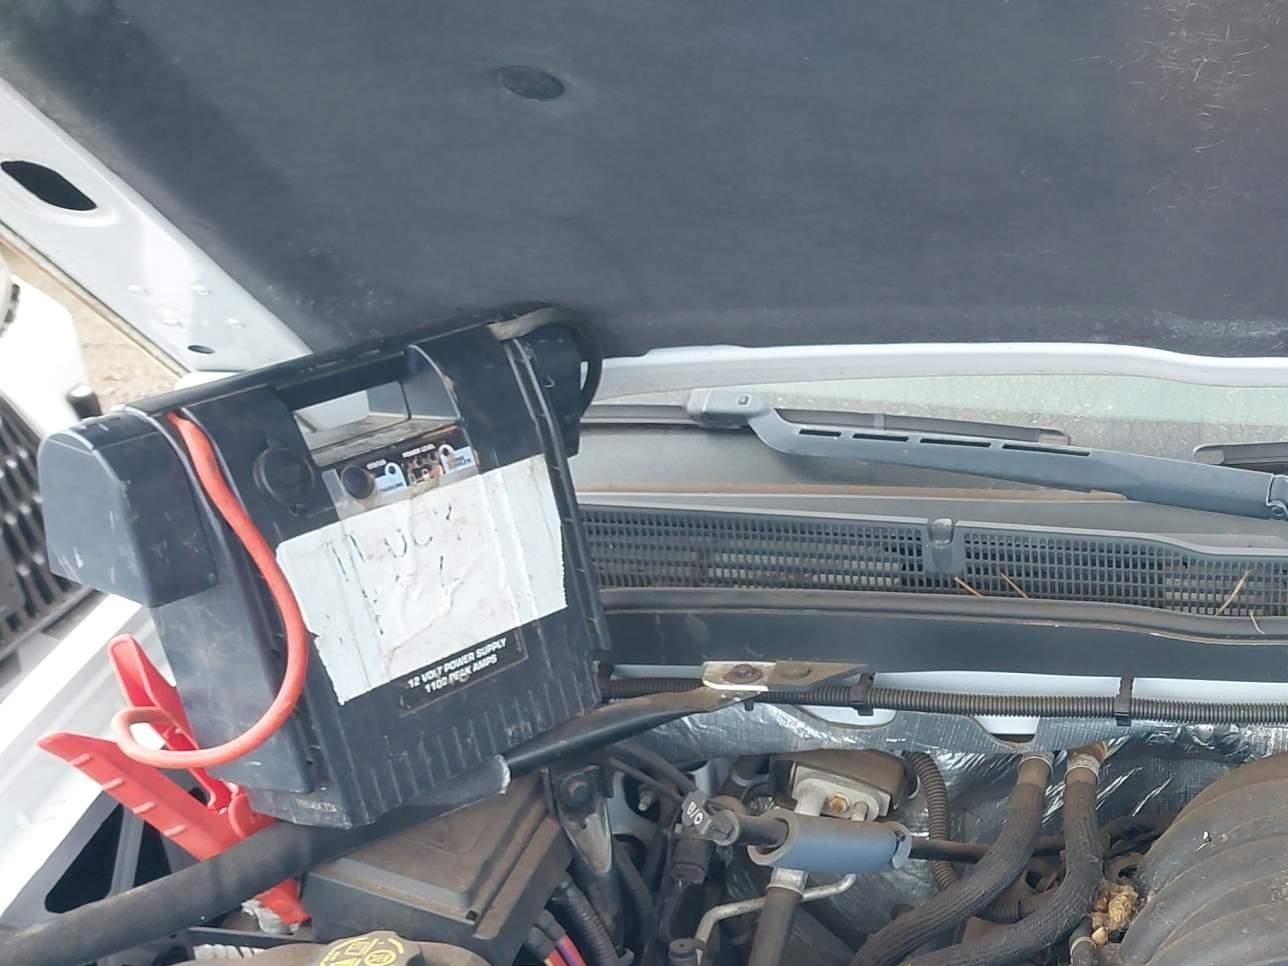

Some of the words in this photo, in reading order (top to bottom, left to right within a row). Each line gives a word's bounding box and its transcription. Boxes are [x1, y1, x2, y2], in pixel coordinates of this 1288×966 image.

[407, 676, 421, 688] 12
[420, 666, 443, 683] VOLT
[443, 652, 476, 673] POWER
[476, 637, 507, 659] SUPPLY
[424, 677, 448, 693] 1100
[448, 666, 472, 682] PEAK
[472, 654, 498, 672] AMPS
